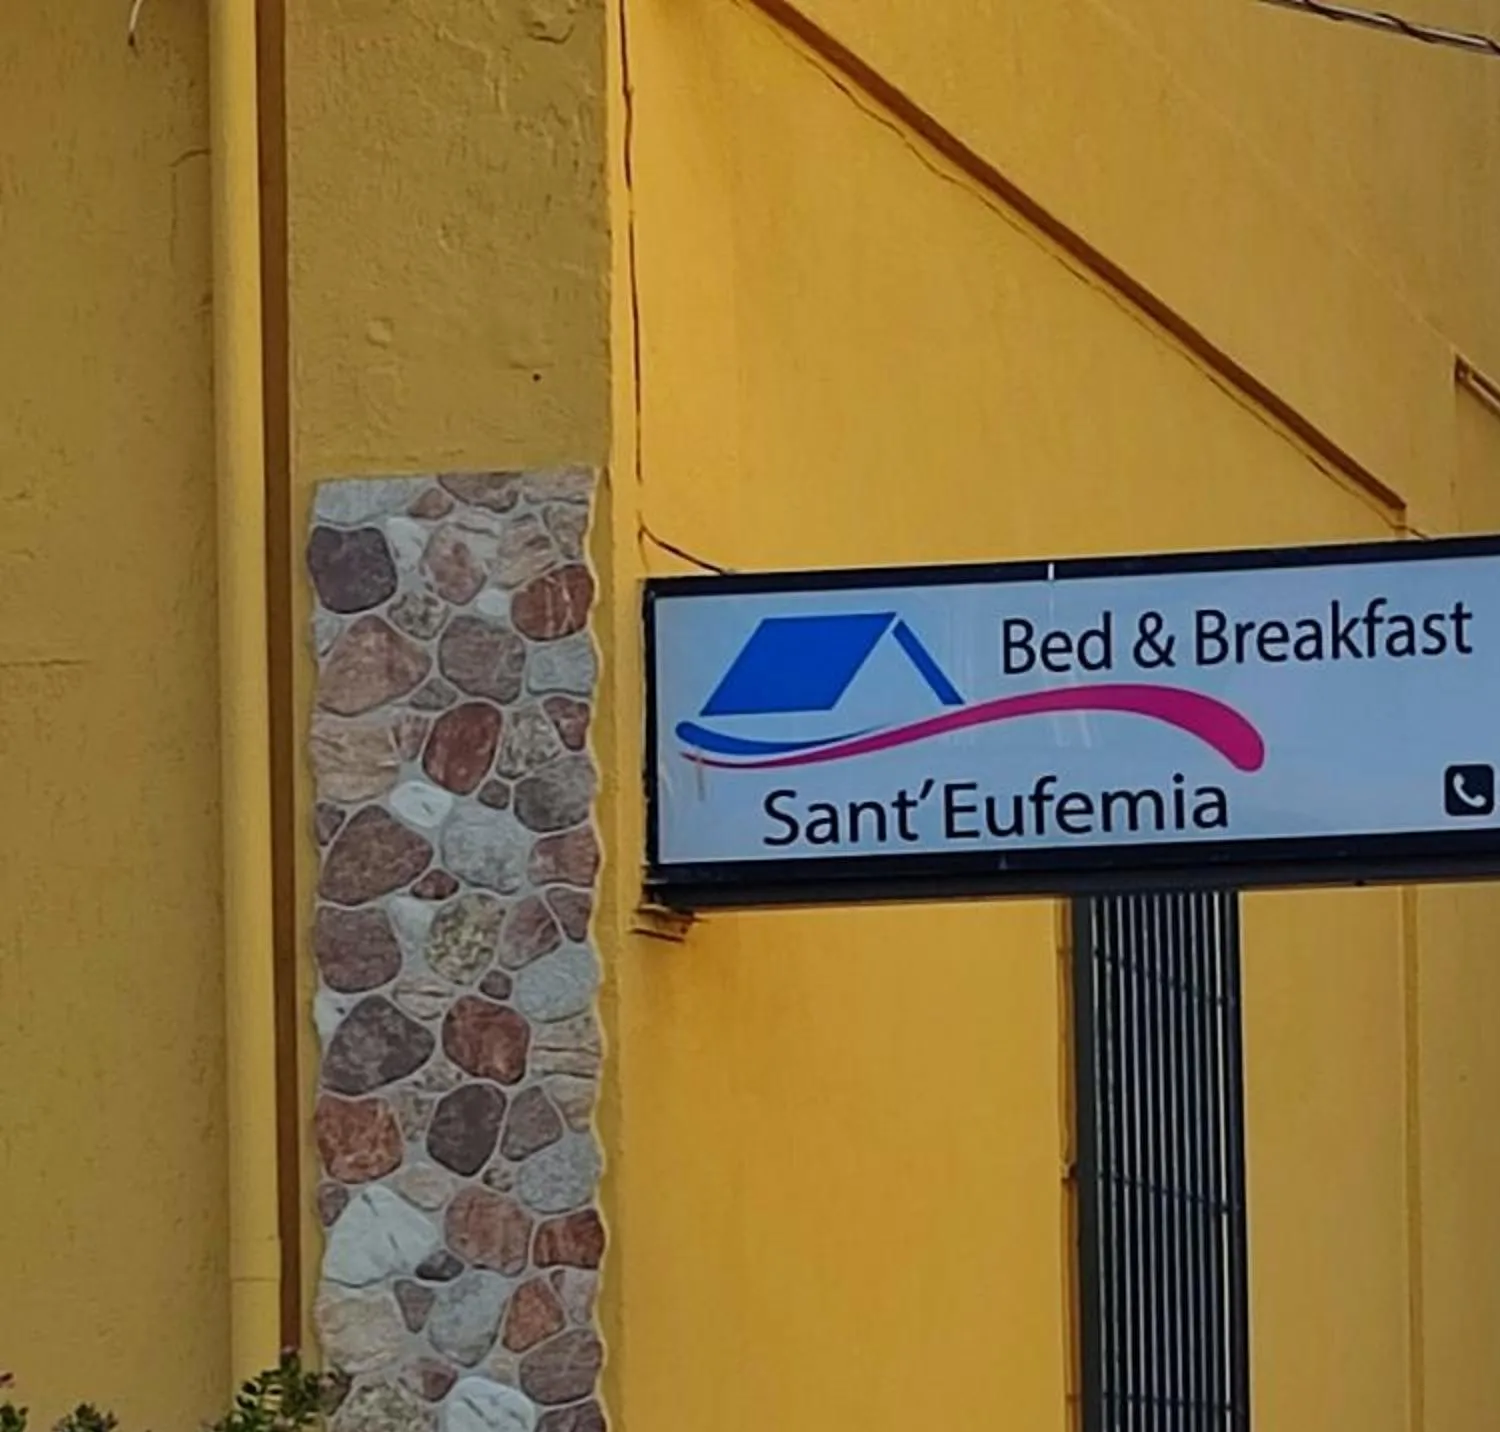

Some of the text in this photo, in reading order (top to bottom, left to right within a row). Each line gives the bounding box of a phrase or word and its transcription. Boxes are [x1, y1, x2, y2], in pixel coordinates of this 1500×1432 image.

[1003, 597, 1473, 675] Bed & Breakfast
[762, 773, 1229, 847] Sant'Eufemia
